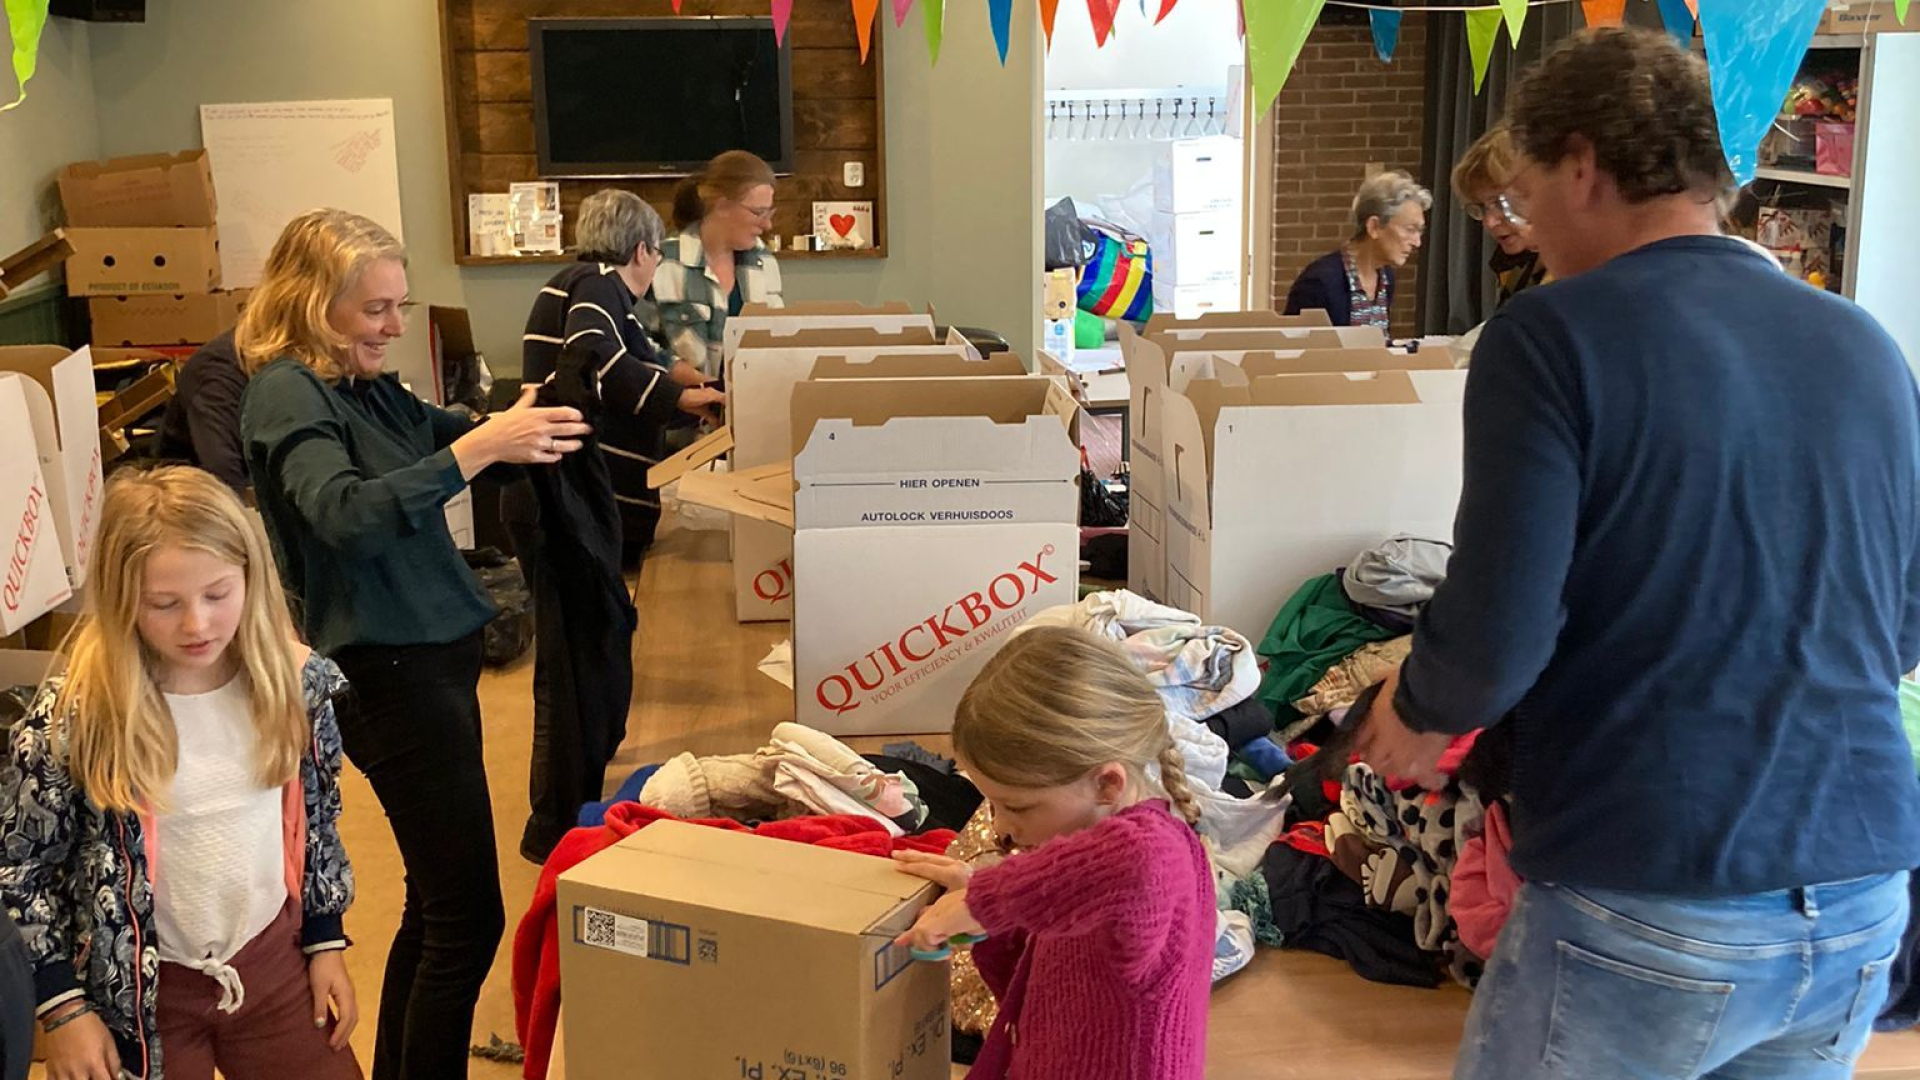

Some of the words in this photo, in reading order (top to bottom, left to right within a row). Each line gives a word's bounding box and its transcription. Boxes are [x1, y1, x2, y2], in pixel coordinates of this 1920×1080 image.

[88, 282, 126, 291] PRODUCT
[141, 282, 181, 291] ECUADOR
[828, 432, 836, 441] 4
[899, 479, 928, 489] HIER
[932, 478, 981, 488] OPENEN
[860, 511, 926, 522] AUTOLOCK
[929, 509, 1014, 521] VERHUISDOOS
[815, 552, 1059, 717] QUICKBOX
[870, 681, 902, 705] VOOR
[902, 644, 963, 689] EFFICIENCY
[964, 641, 973, 651] &
[974, 607, 1029, 646] KWALITEIT
[830, 1060, 847, 1077] 96
